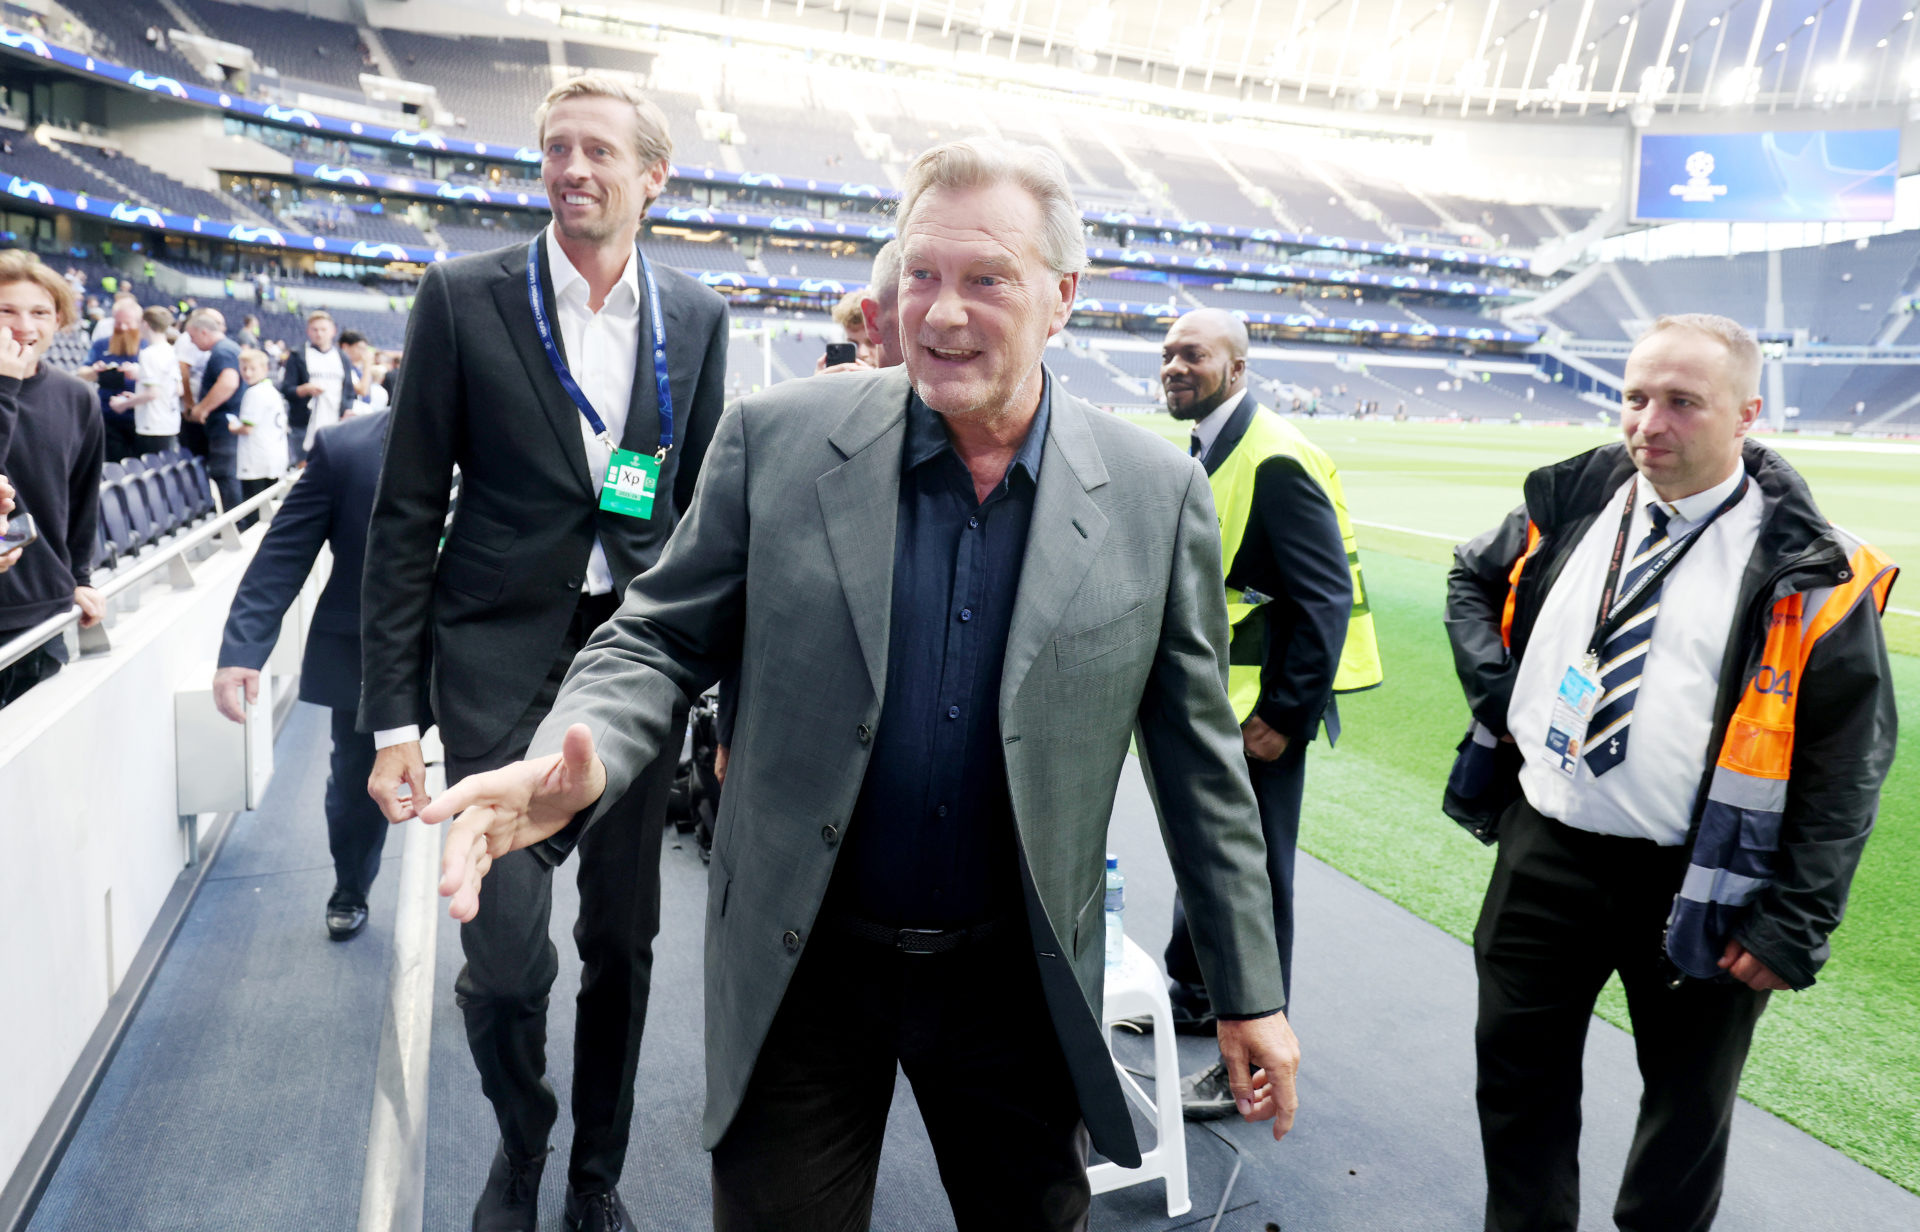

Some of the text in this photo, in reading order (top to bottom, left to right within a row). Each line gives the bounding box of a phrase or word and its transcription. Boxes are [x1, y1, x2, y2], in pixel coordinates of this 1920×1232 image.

[539, 320, 547, 338] UEFA
[622, 471, 640, 486] Xp
[1754, 665, 1793, 704] 04
